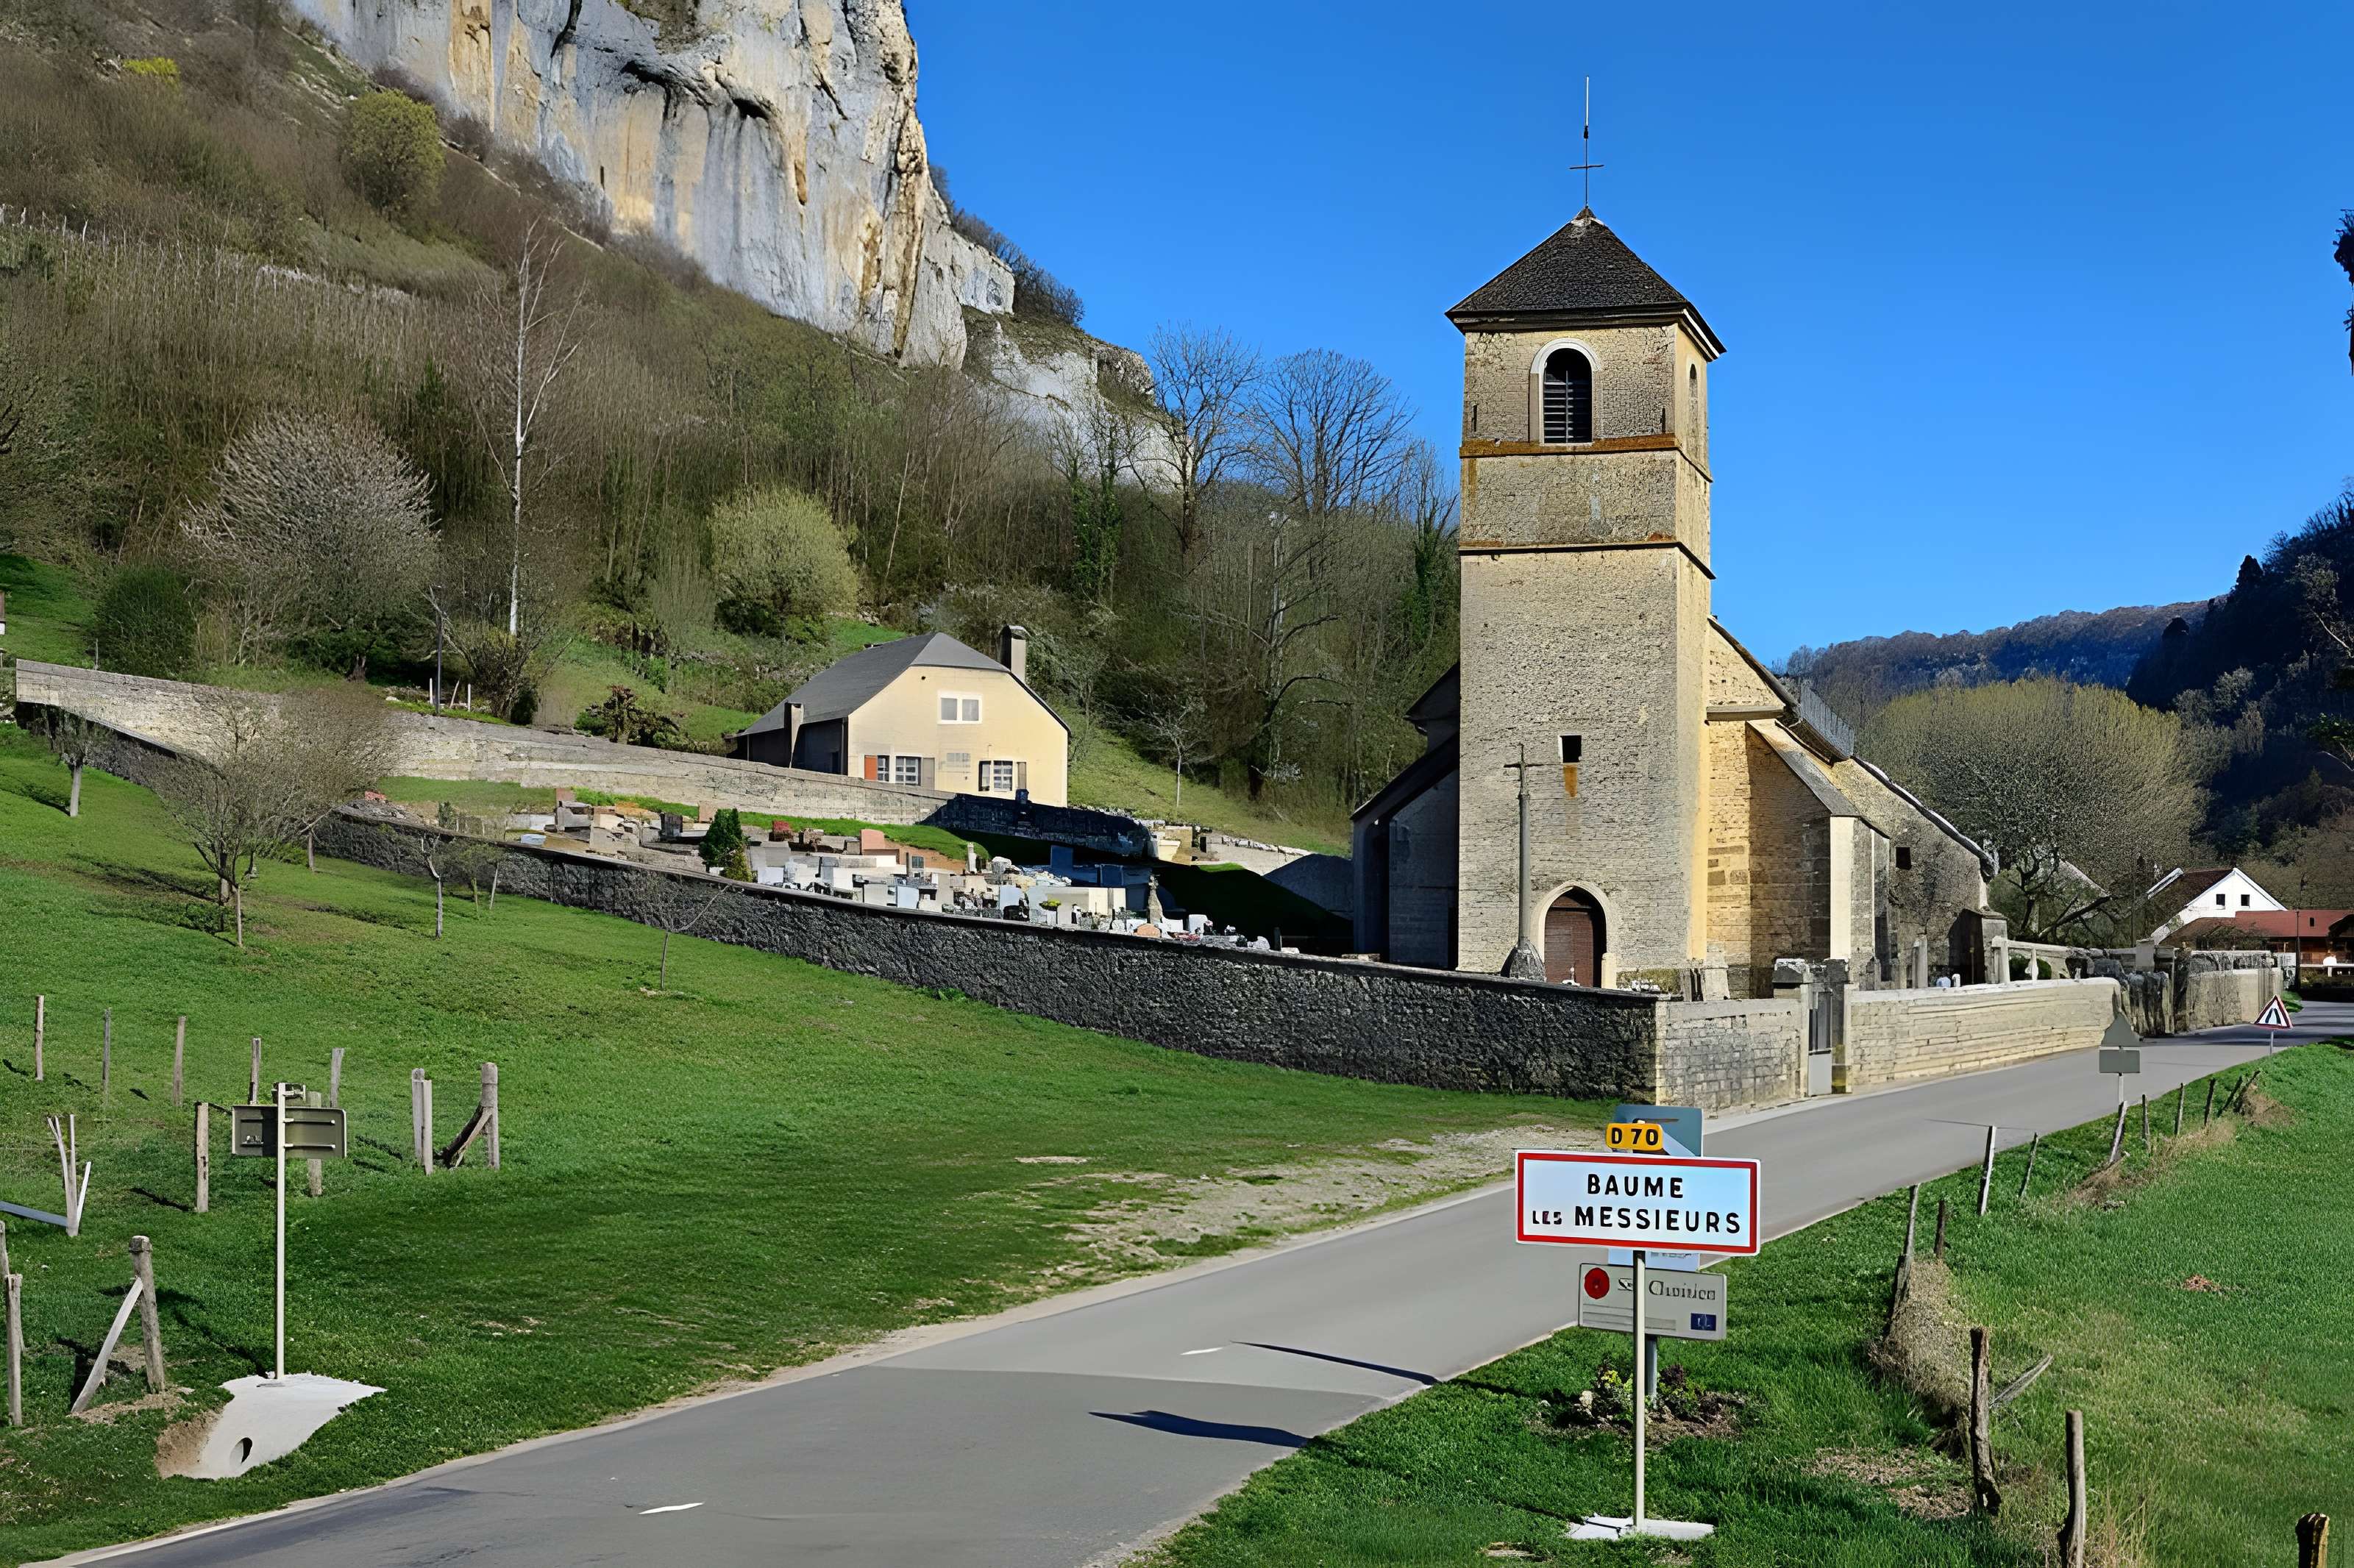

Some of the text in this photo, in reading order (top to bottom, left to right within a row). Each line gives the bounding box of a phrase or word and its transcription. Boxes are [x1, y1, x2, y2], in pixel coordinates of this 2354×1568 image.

[1611, 1127, 1659, 1146] D 70
[1587, 1173, 1684, 1199] BAUME
[1532, 1205, 1741, 1234] LES MESSIEURS
